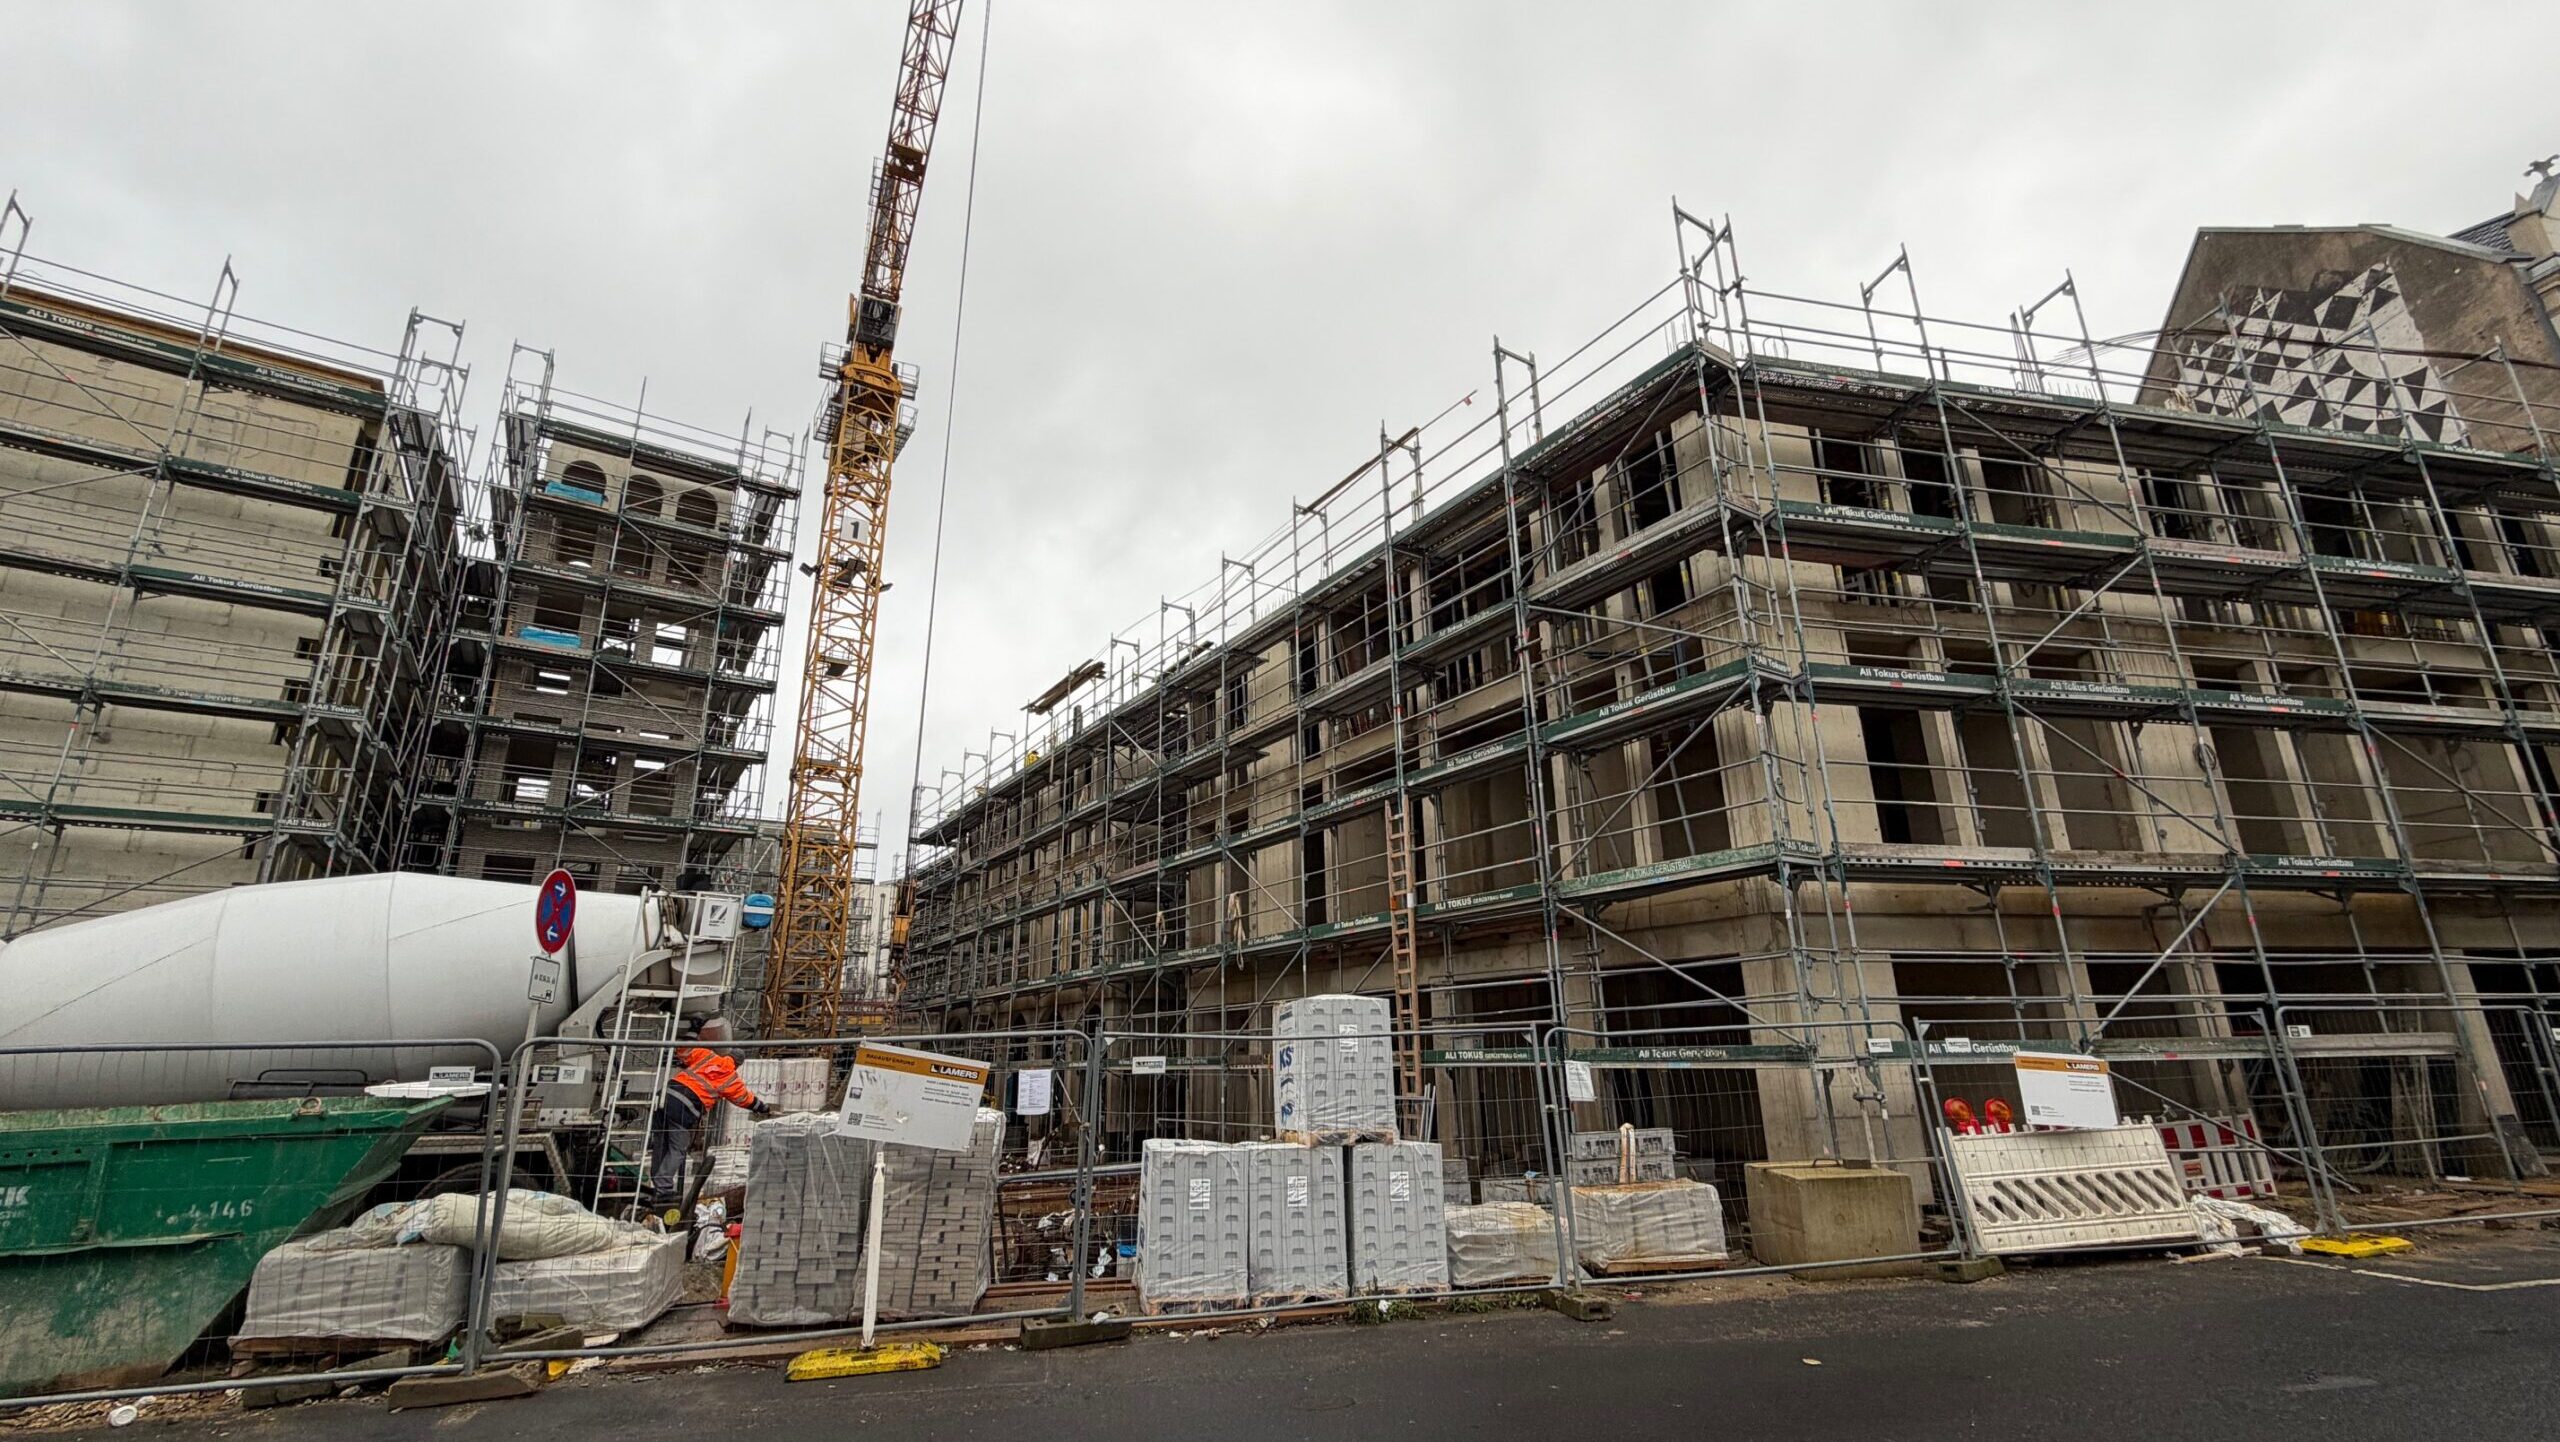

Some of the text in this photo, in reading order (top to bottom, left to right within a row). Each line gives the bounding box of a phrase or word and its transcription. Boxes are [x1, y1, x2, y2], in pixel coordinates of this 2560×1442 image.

[27, 309, 48, 320] ALI
[51, 314, 93, 331] TOKUS
[270, 370, 295, 381] Tokus
[1841, 507, 1865, 518] Tokus
[1867, 510, 1910, 523] Gerüstbau
[850, 521, 860, 540] 1
[207, 576, 235, 586] Tokus
[1860, 667, 1945, 682] Ali Tokus Gerüstbau
[1598, 684, 1676, 718] Ali Tokus Gerüstbau
[2240, 694, 2264, 703] Tokus
[2289, 857, 2313, 867] Tokus
[1435, 903, 1446, 911] ALI
[1447, 897, 1472, 909] TOKUS
[1638, 1049, 1650, 1059] Ali
[1652, 1049, 1677, 1059] Tokus
[1929, 1043, 1942, 1054] Ali
[1972, 1043, 2020, 1054] Gerüstbau
[1445, 1051, 1457, 1060] ALI
[1458, 1051, 1484, 1060] TOKUS
[940, 1065, 979, 1079] LAMERS
[2072, 1063, 2100, 1071] LAMERS
